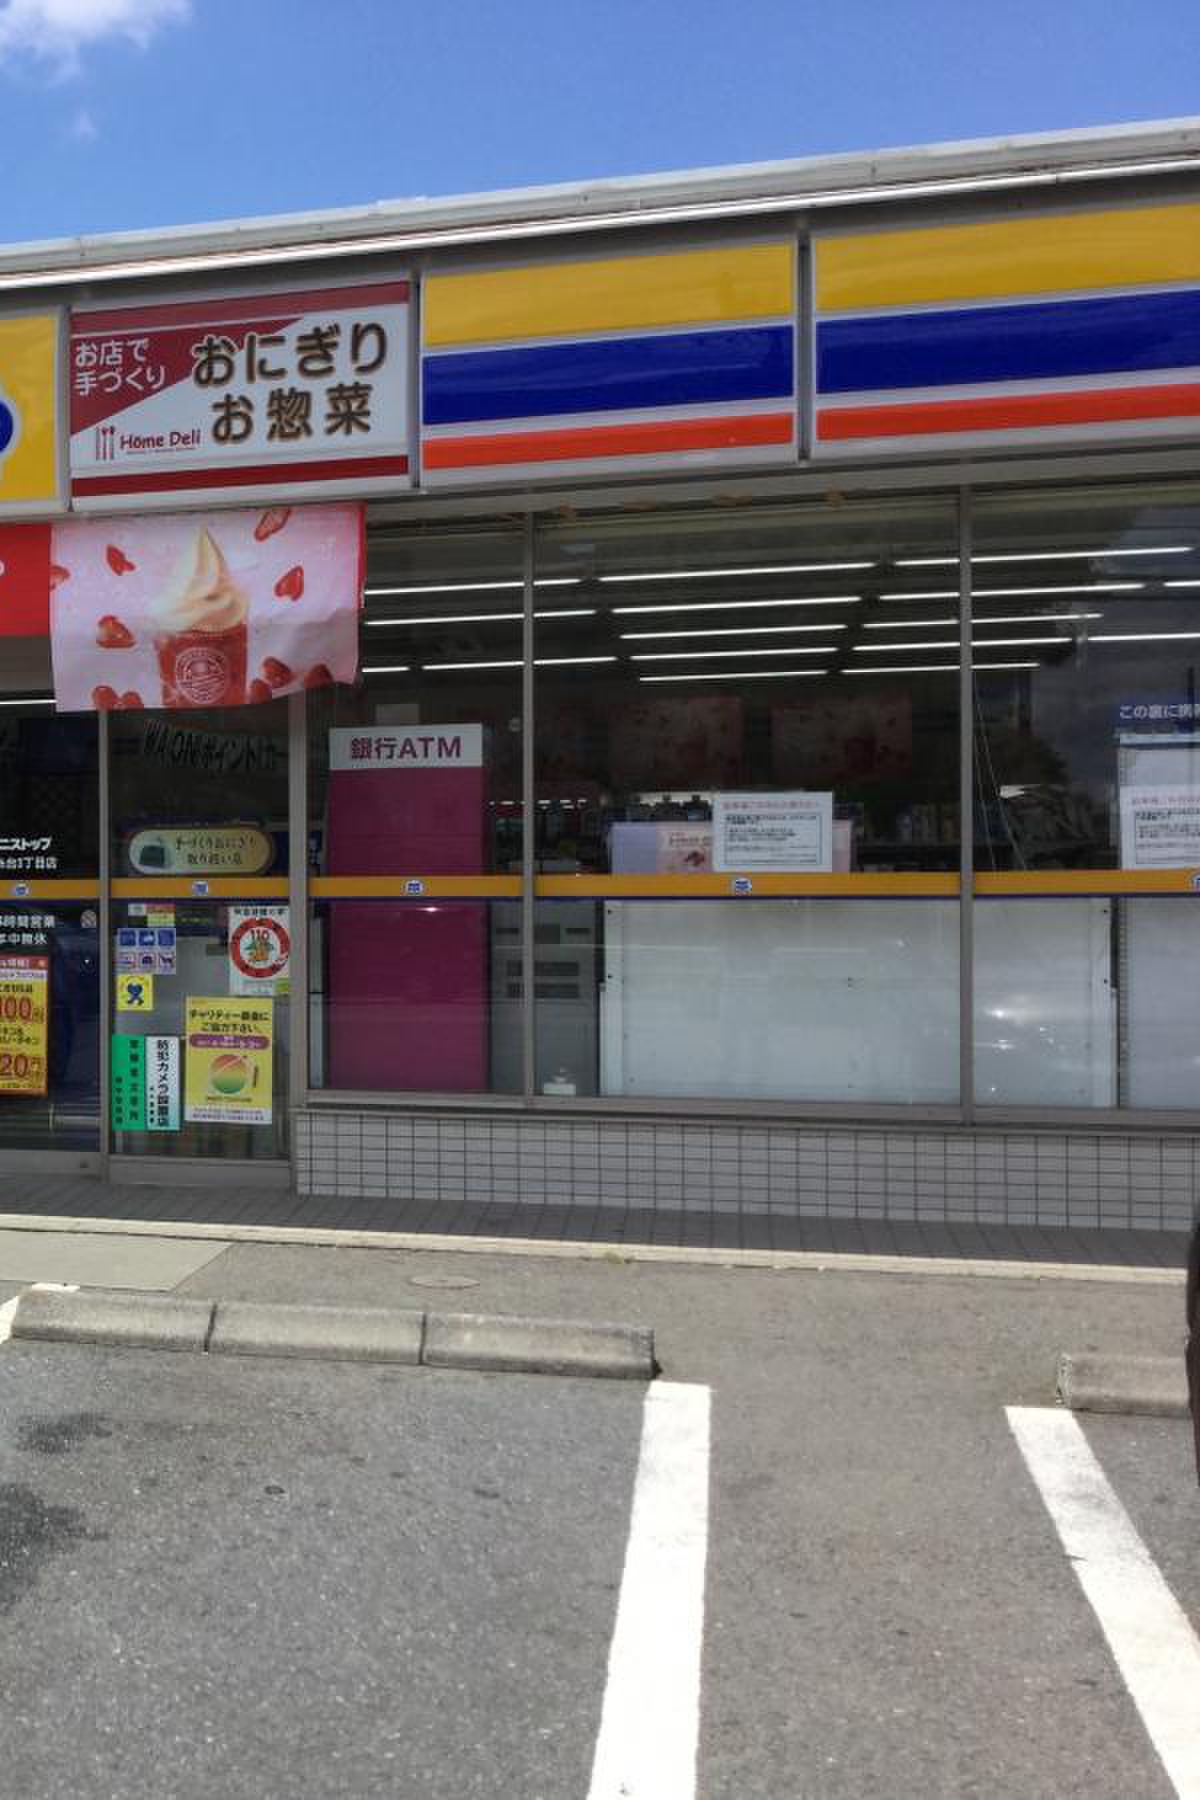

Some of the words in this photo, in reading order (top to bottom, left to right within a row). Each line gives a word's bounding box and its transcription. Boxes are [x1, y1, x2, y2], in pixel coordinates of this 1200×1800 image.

[76, 339, 149, 367] お店で
[192, 322, 387, 388] おにぎり
[74, 366, 165, 396] 手づくり
[210, 381, 373, 445] お惣菜
[120, 433, 164, 449] Home
[169, 429, 201, 447] Deli
[351, 736, 461, 760] 銀行ATM
